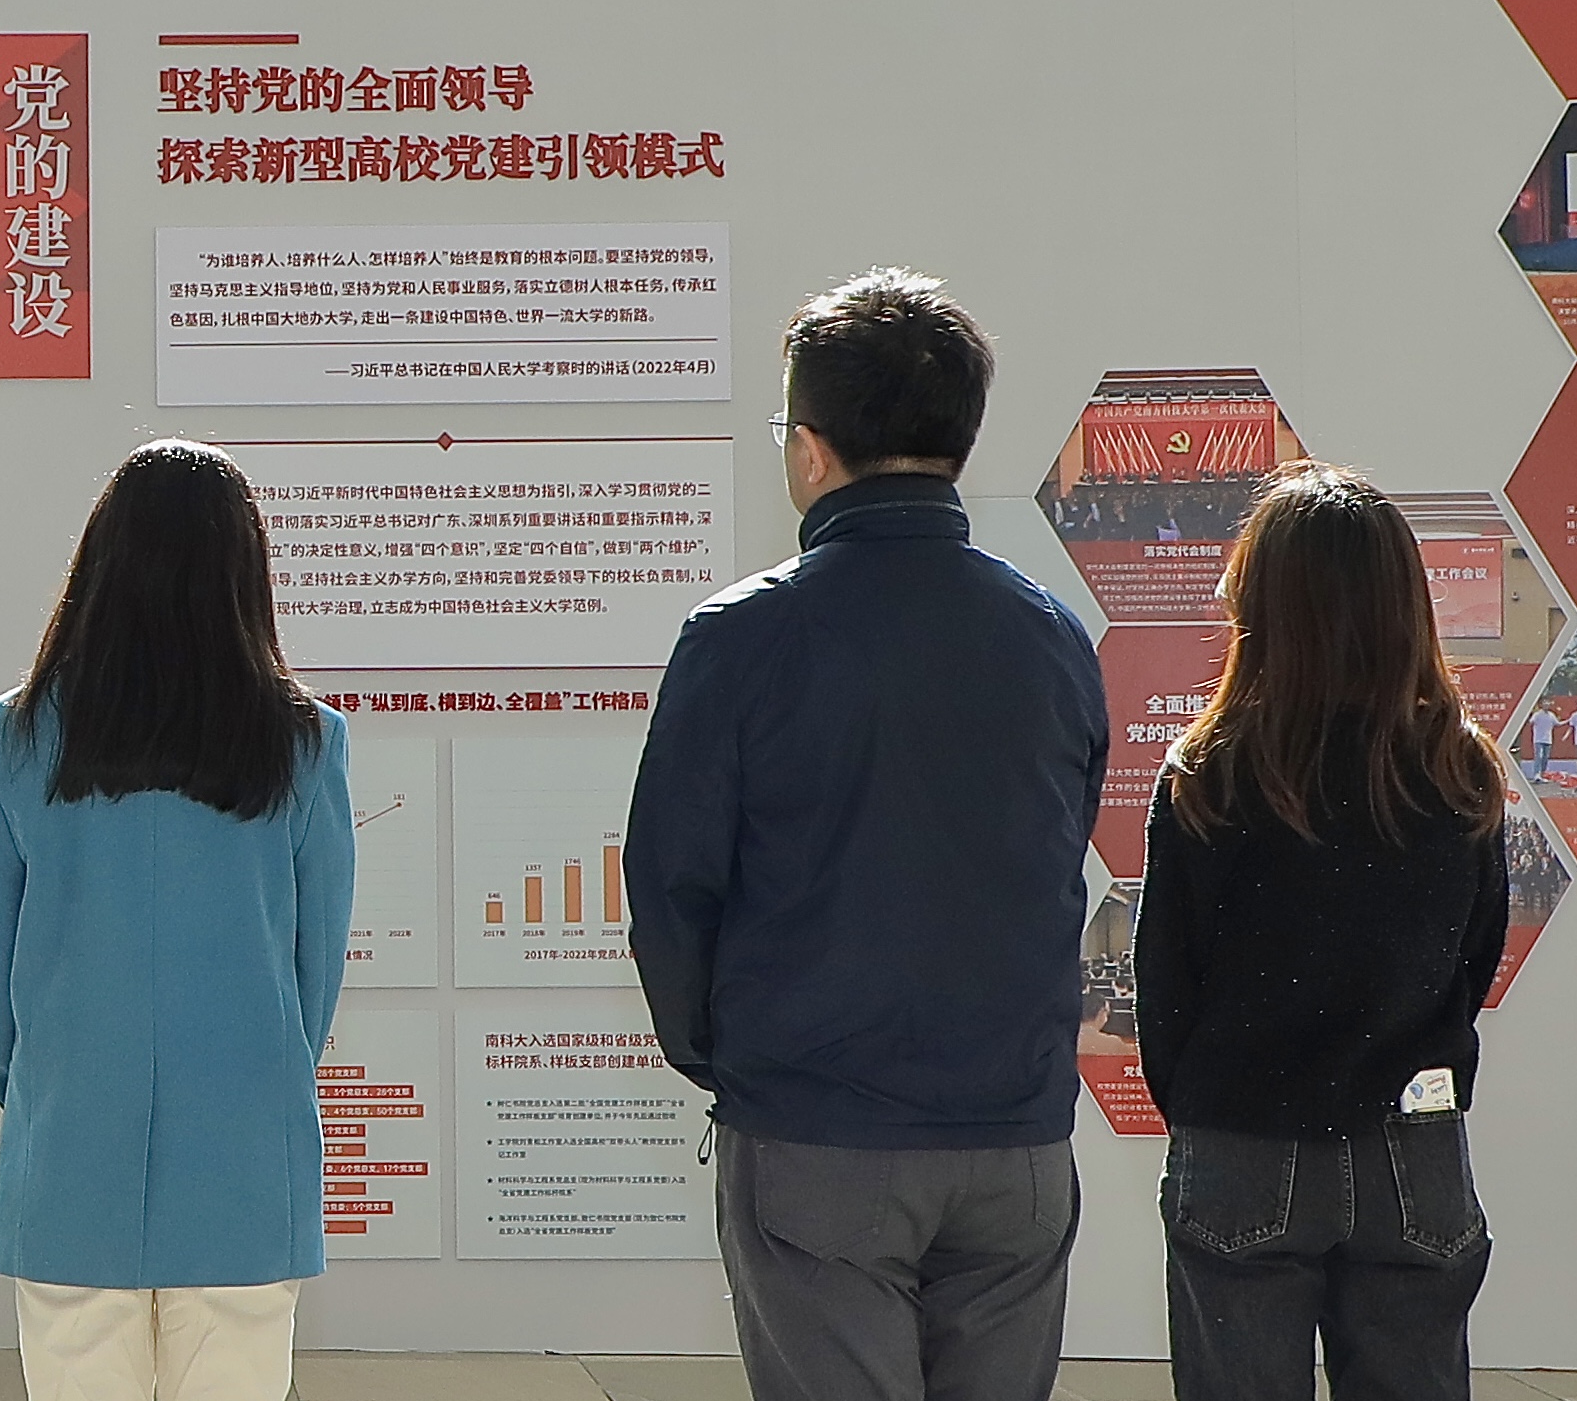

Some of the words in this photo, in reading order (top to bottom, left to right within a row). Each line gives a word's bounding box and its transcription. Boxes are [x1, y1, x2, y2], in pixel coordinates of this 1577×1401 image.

[156, 63, 536, 115] 坚持党的全面领导
[156, 131, 728, 185] 探索新型高校党建引领模式
[2, 62, 74, 341] 党的建设
[199, 249, 714, 269] “为谁培养人、培养什么人、怎样培养人”始终是教育的根本问题。要坚持党的领导，
[168, 277, 718, 299] 坚持马克思主义指导地位，坚持为党和人民事业服务，落实立德树人根本任务，传承红
[169, 307, 656, 329] 色基因，扎根中国大地办大学，走出一条建设中国特色、世界一流大学的新路。
[485, 1033, 660, 1048] 南科大入选国家级和省级党
[485, 1054, 665, 1070] 标杆院系、样板支部创建单位
